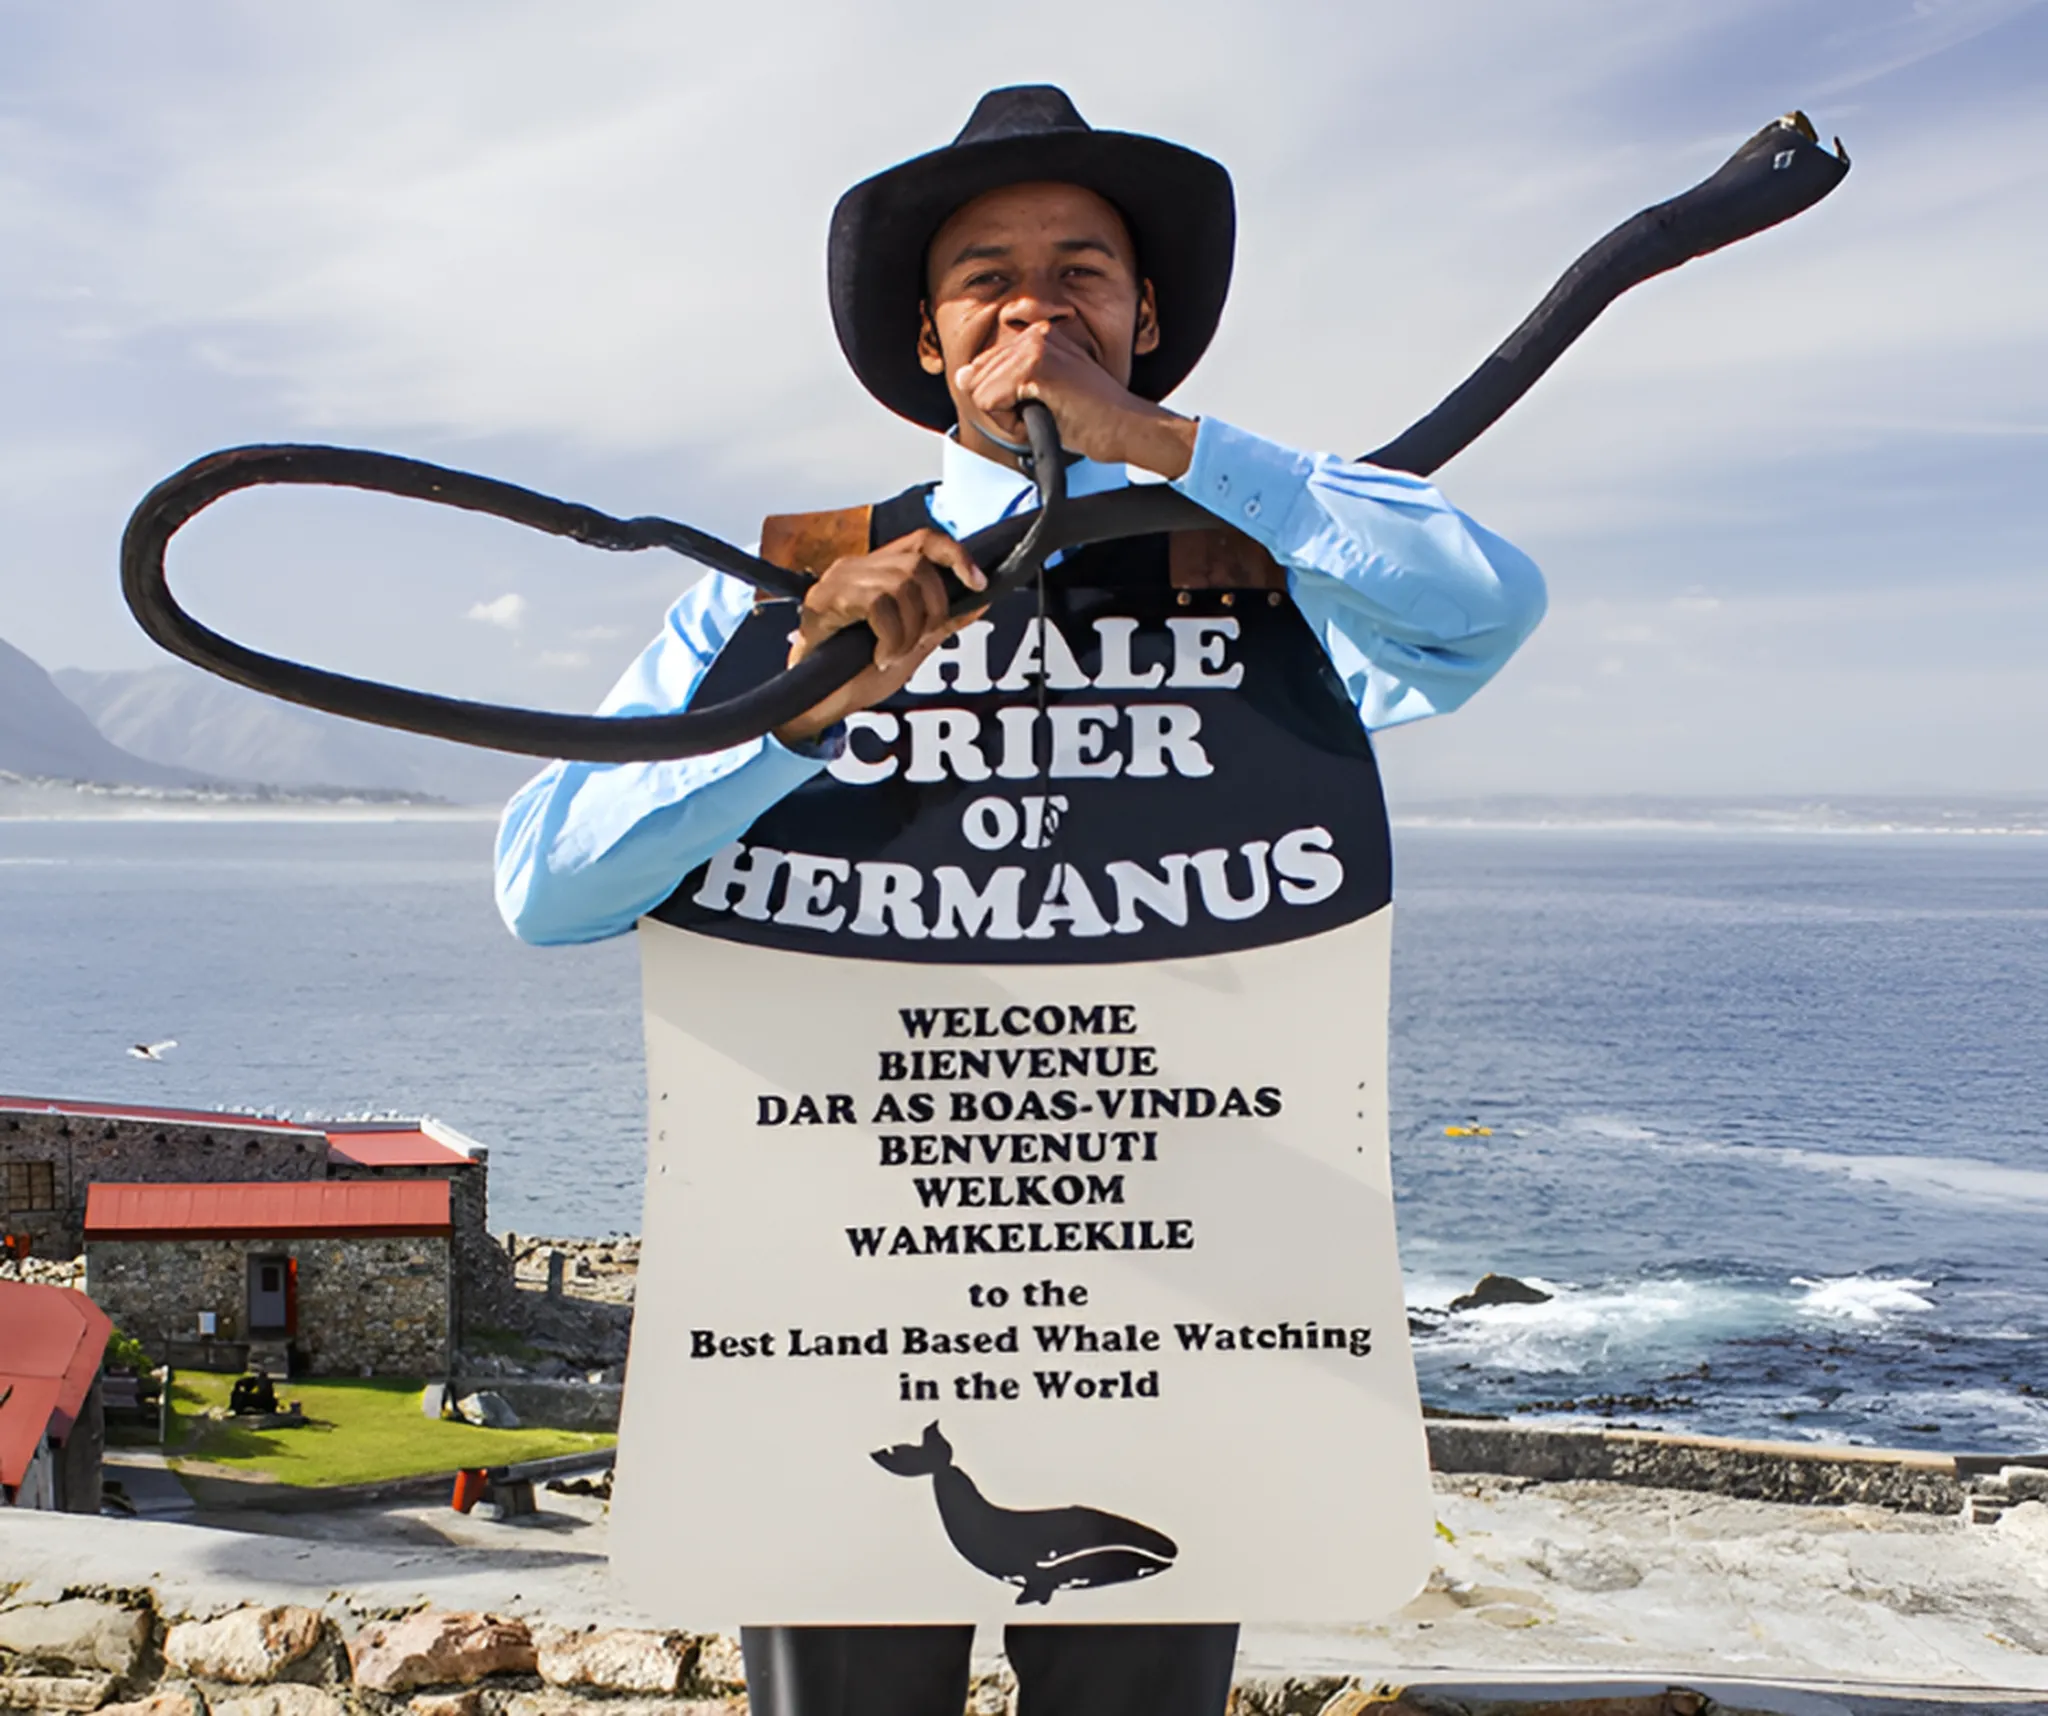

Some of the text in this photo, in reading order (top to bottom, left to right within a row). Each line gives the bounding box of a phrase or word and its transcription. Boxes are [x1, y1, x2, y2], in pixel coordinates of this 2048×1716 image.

[787, 616, 1245, 693] HALE
[826, 703, 1215, 785] CRIER
[961, 794, 1070, 851] OF
[692, 825, 1345, 940] HERMANUS
[898, 1004, 1137, 1039] WELCOME
[878, 1046, 1159, 1081] BIENVENUE
[756, 1086, 1282, 1126] DAR AS BOAS-VINDAS
[878, 1131, 1158, 1166] BENVENUTI
[912, 1174, 1125, 1208] WELKOM
[845, 1219, 1194, 1257] WAMKELEKILE
[968, 1279, 1088, 1308] to the
[690, 1321, 1372, 1359] Best Land Based Whale Watching
[899, 1370, 1159, 1401] in the World
